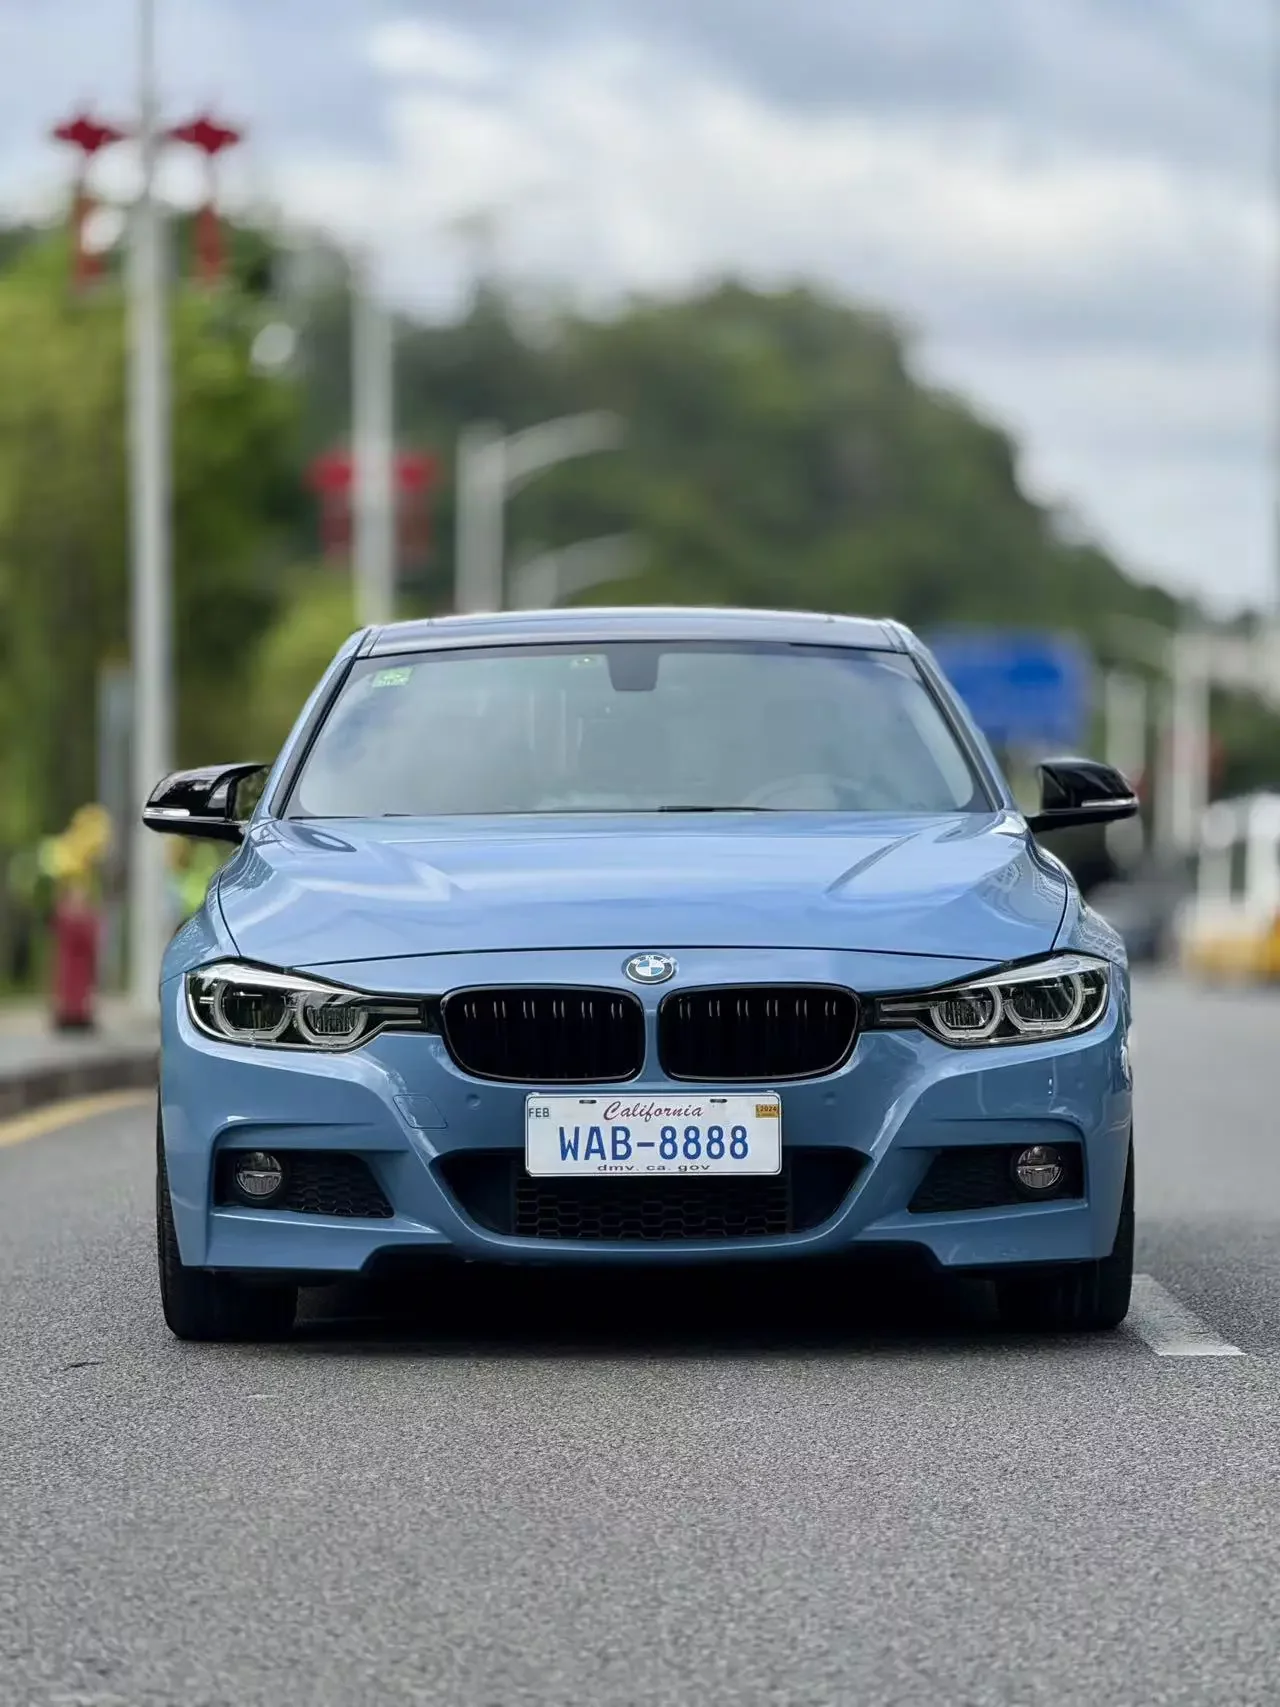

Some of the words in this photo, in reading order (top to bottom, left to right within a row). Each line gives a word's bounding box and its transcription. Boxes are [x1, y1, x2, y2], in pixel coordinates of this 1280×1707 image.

[528, 1107, 550, 1118] FEB
[603, 1101, 704, 1122] California
[558, 1125, 749, 1161] WAB-8888
